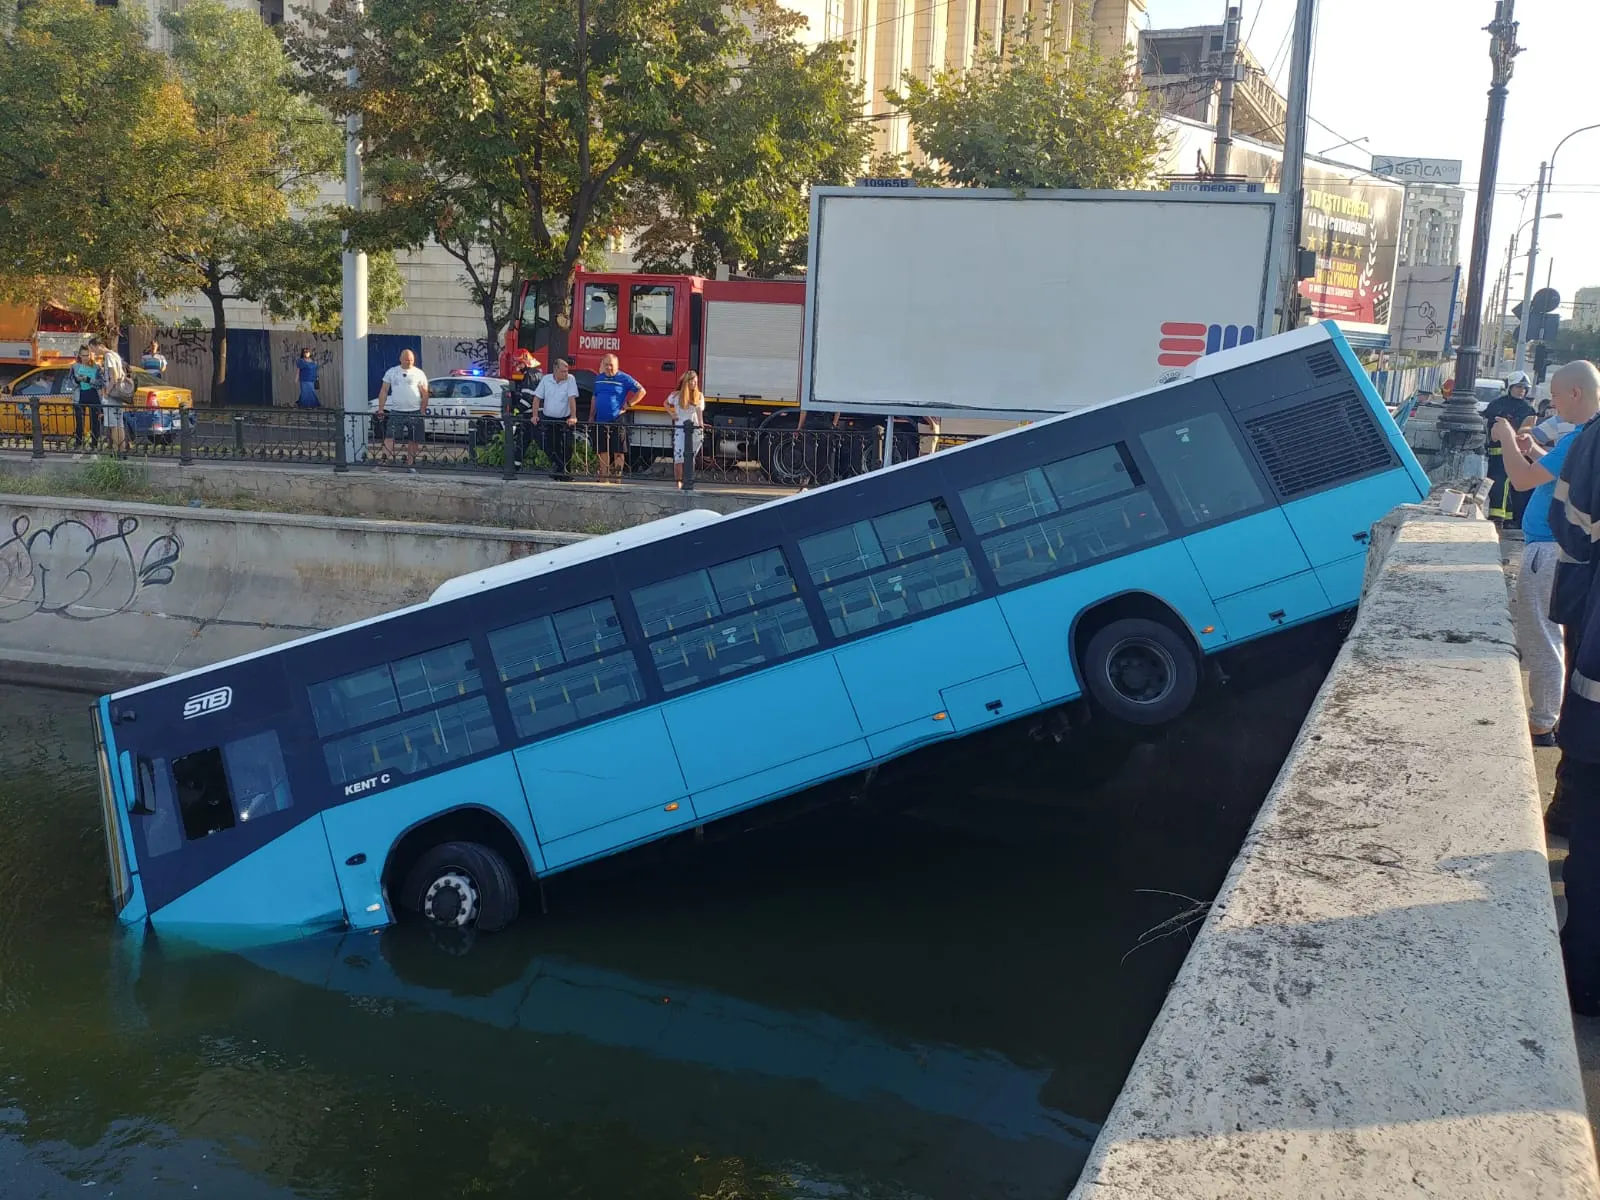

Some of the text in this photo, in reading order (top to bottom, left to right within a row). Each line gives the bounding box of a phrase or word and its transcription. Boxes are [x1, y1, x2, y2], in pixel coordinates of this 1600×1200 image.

[1395, 164, 1442, 177] GETICA
[1311, 190, 1321, 208] TU
[1308, 211, 1317, 227] LA
[1316, 270, 1358, 289] HOLLYWOOD
[579, 336, 620, 350] POMPIERI
[424, 407, 467, 417] OLITIA
[183, 690, 227, 716] STB
[344, 773, 391, 796] KENT C
